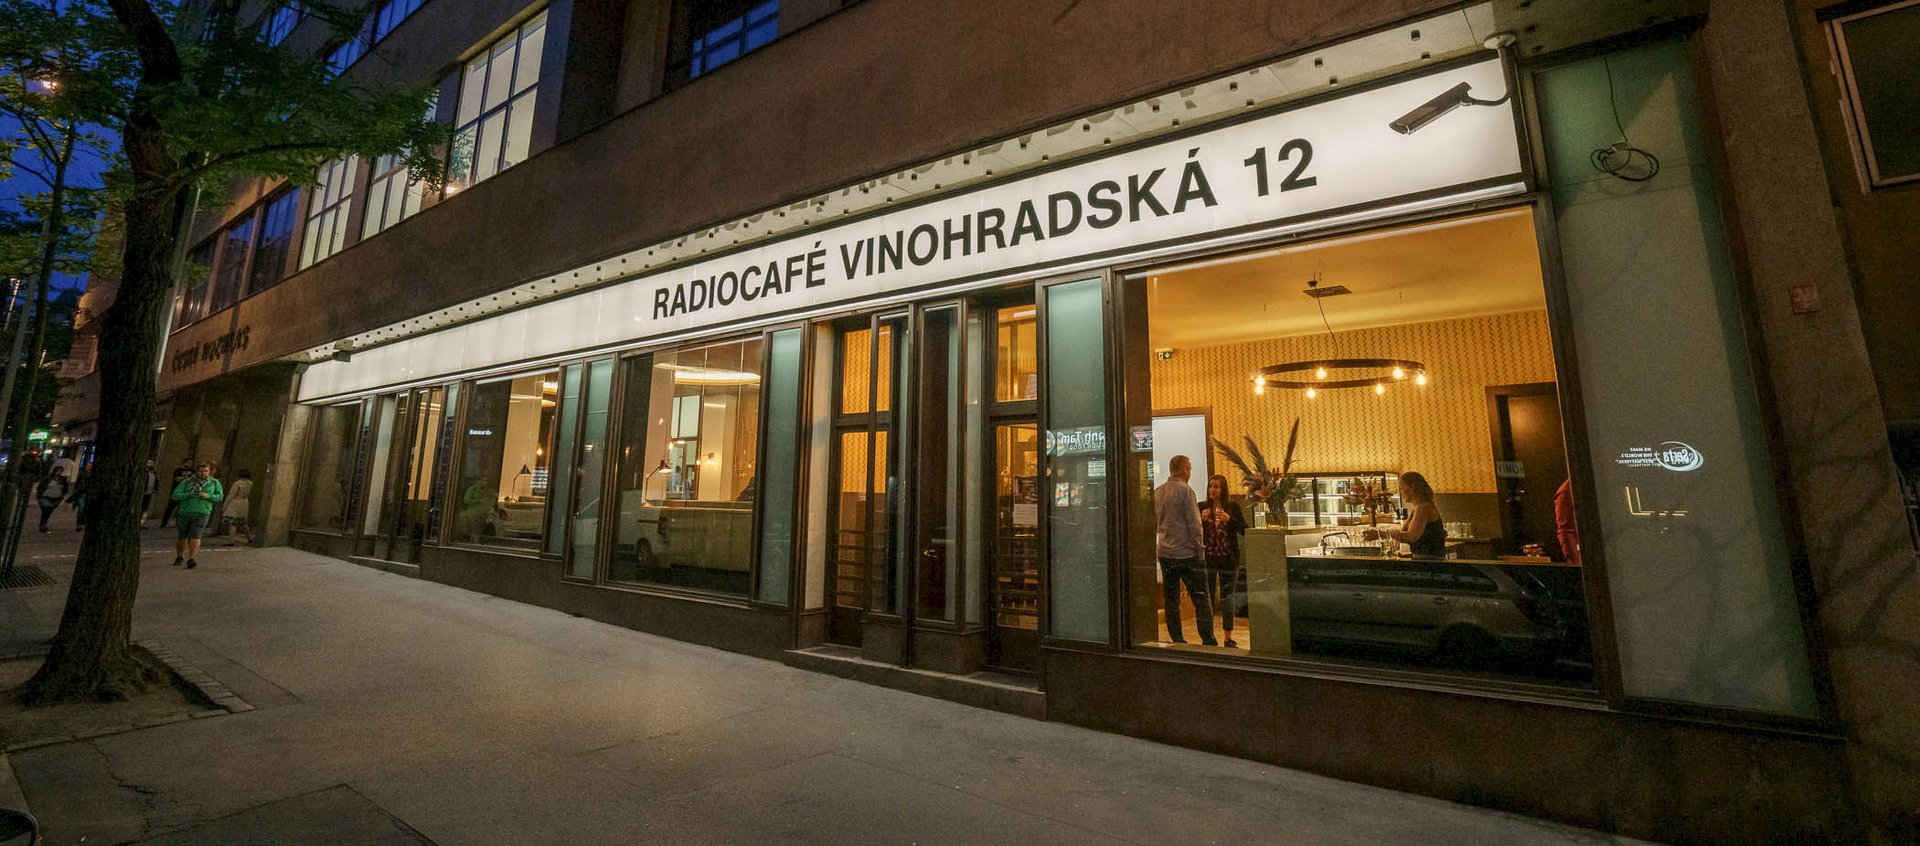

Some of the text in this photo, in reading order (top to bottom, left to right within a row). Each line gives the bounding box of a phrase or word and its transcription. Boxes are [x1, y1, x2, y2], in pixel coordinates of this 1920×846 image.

[652, 138, 1318, 320] RADIOCAFÉ VINOHRADSKÁ 12
